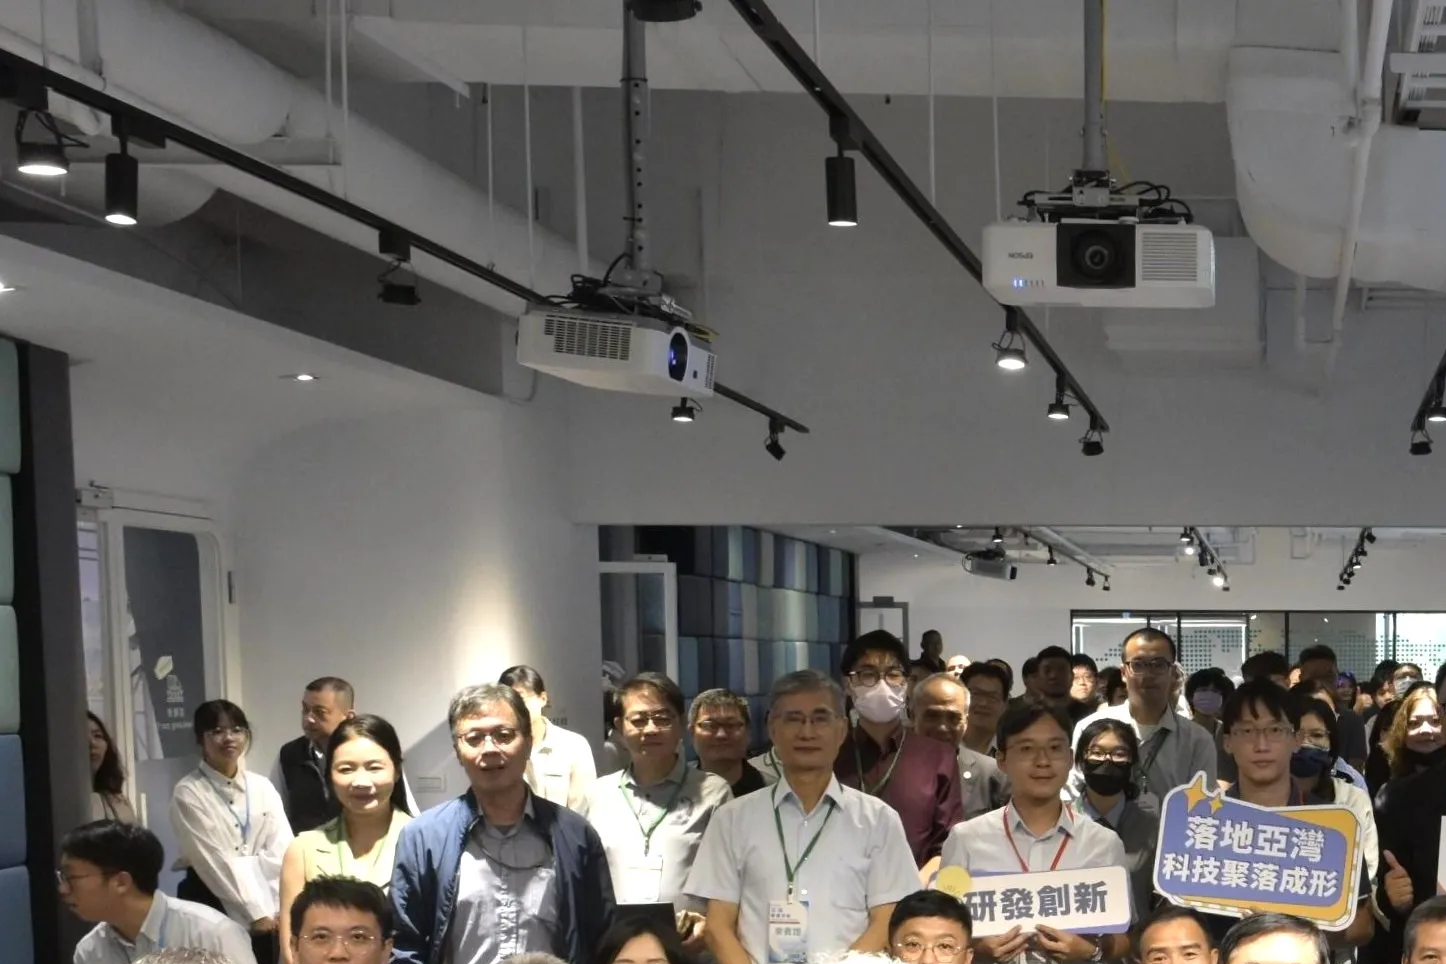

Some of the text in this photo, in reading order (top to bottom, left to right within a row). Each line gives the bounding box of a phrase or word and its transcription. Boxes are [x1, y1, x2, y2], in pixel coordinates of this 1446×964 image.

[1185, 816, 1325, 863] 落地亞灣
[1163, 853, 1339, 898] 科技聚落成形
[963, 880, 1108, 923] 研發創新
